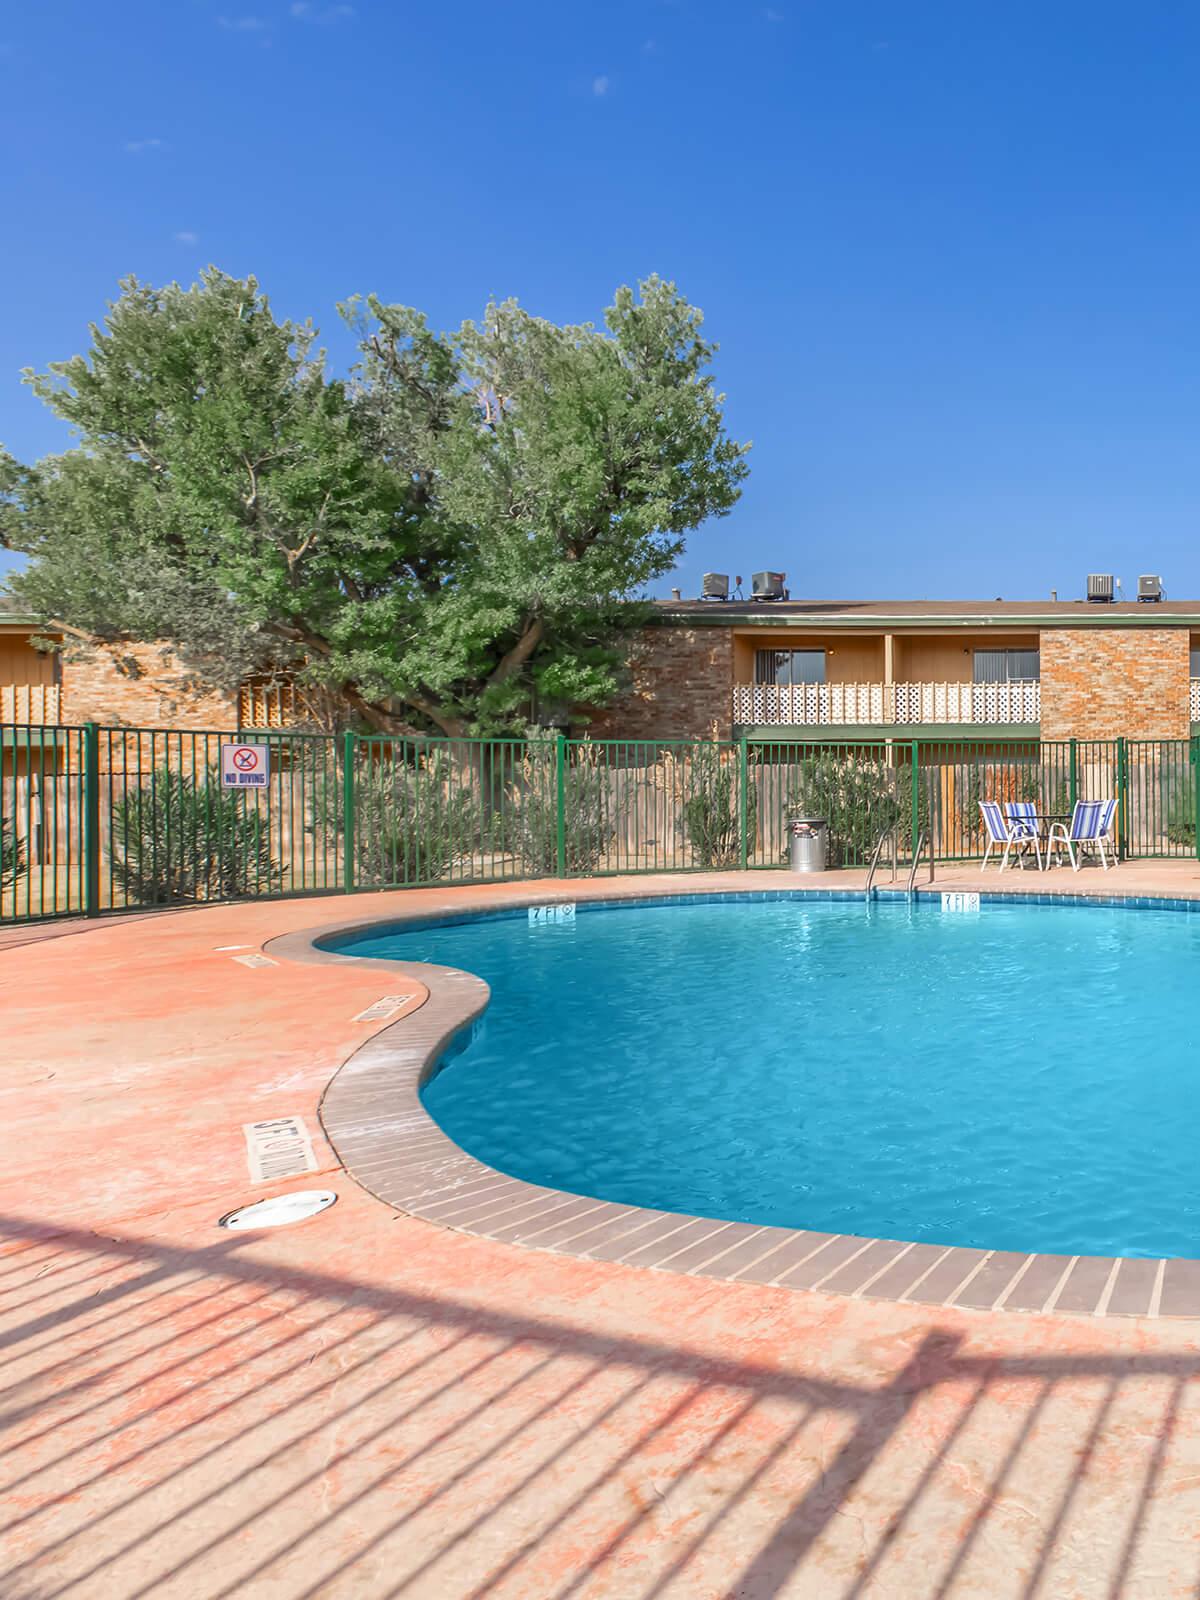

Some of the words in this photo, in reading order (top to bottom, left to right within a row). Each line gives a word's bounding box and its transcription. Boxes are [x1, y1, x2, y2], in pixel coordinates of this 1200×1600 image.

[225, 773, 237, 784] NO
[239, 773, 265, 784] DIVING
[955, 893, 966, 905] FT
[534, 908, 541, 919] 7
[546, 905, 557, 919] FT
[253, 1120, 294, 1129] 3
